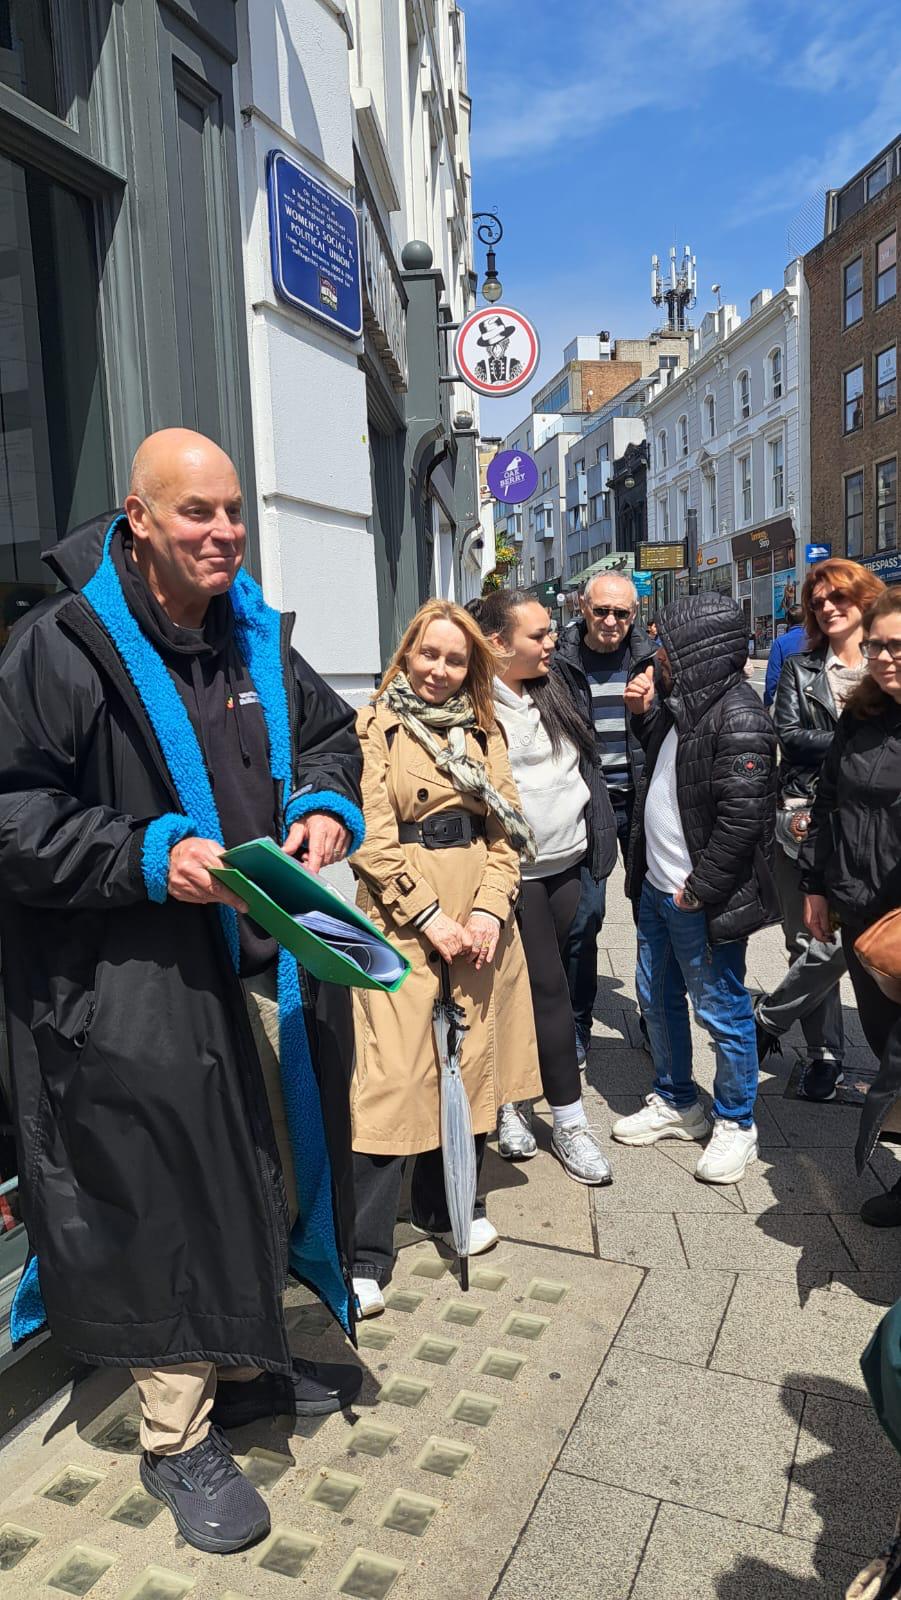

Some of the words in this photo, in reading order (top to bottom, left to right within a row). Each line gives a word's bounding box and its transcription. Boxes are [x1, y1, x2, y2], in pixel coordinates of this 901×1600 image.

[303, 188, 309, 198] On
[311, 194, 319, 205] this
[283, 193, 294, 203] were
[307, 209, 324, 226] regional
[326, 222, 339, 236] offices
[297, 191, 310, 206] North
[311, 202, 325, 217] Street
[327, 214, 345, 231] Quadrant
[284, 203, 320, 236] WOMEN'S
[322, 230, 345, 254] SOCIAL
[291, 222, 326, 254] POLITICAL
[328, 247, 350, 269] UNION
[311, 250, 329, 266] between
[292, 246, 318, 267] Suffragettes
[320, 264, 343, 284] campaigned
[500, 473, 525, 488] BERRY
[504, 468, 520, 478] OAK
[863, 557, 898, 572] TRESPASS
